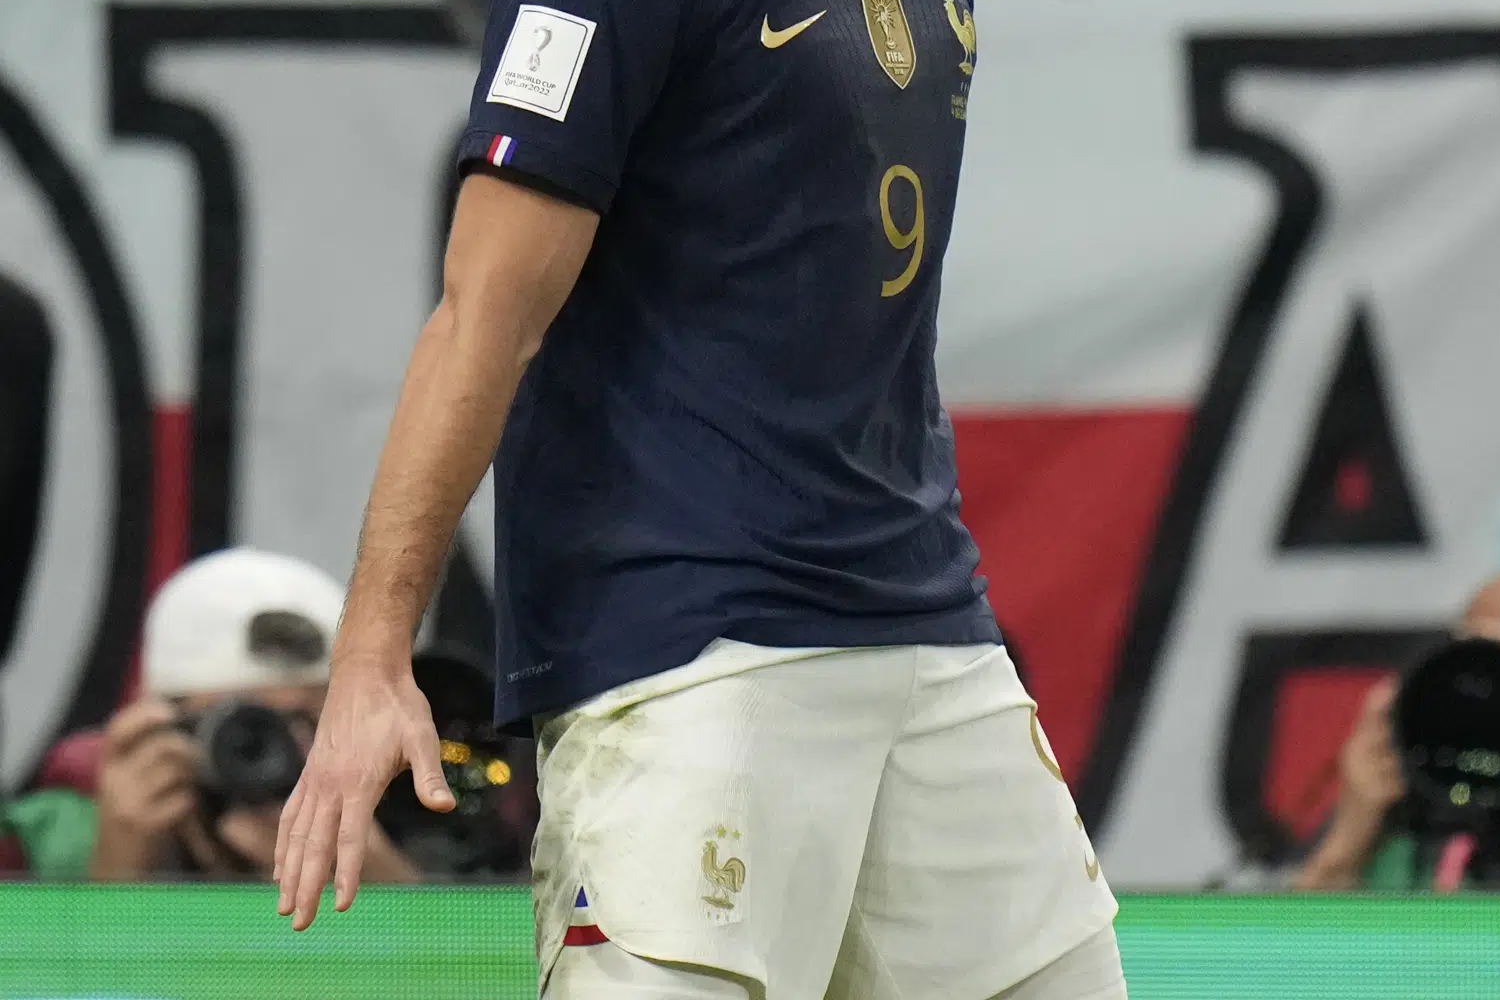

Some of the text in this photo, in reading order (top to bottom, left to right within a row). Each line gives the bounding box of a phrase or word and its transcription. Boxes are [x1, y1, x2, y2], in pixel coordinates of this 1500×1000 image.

[886, 51, 905, 63] FIFA
[517, 73, 542, 86] WORLD
[542, 80, 557, 89] CUP
[879, 164, 925, 297] 9
